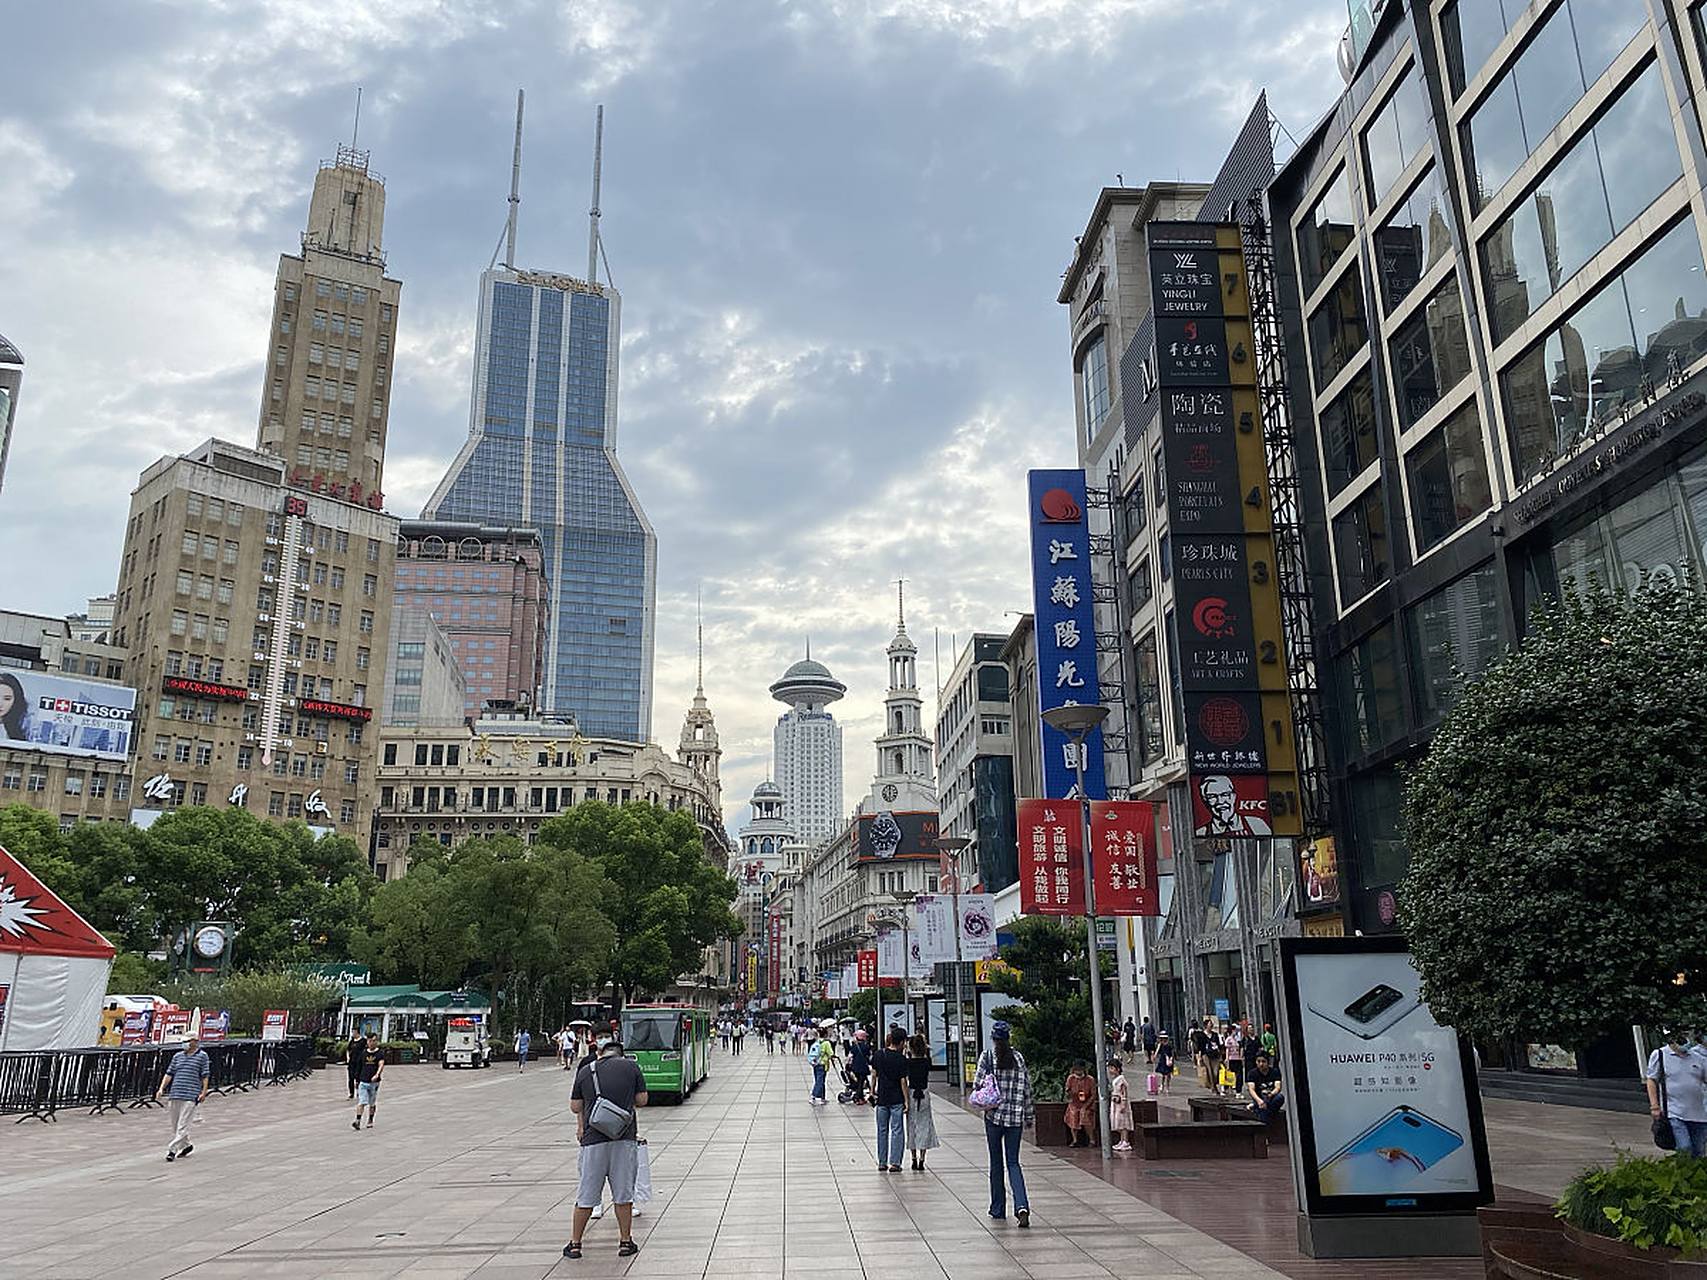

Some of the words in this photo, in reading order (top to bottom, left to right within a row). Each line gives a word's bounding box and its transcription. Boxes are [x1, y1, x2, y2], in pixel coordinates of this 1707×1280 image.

[1160, 273, 1213, 286] 英立珠宝
[1225, 273, 1238, 295] 7
[1162, 289, 1196, 298] YINGLI
[1164, 302, 1208, 311] JEWELRY
[1231, 342, 1247, 364] 6
[1171, 393, 1224, 415] 陶瓷
[1239, 412, 1253, 434] 5
[1245, 486, 1262, 509] 4
[1182, 544, 1238, 561] 珍珠城
[1252, 561, 1269, 584] 3
[1260, 640, 1277, 664] 2
[1049, 539, 1088, 800] 江蘇陽光團
[73, 703, 131, 719] TISSOT
[1271, 720, 1282, 745] 1
[1239, 800, 1268, 810] KFC
[1330, 1053, 1375, 1063] HUAWEI
[1379, 1053, 1396, 1062] P40
